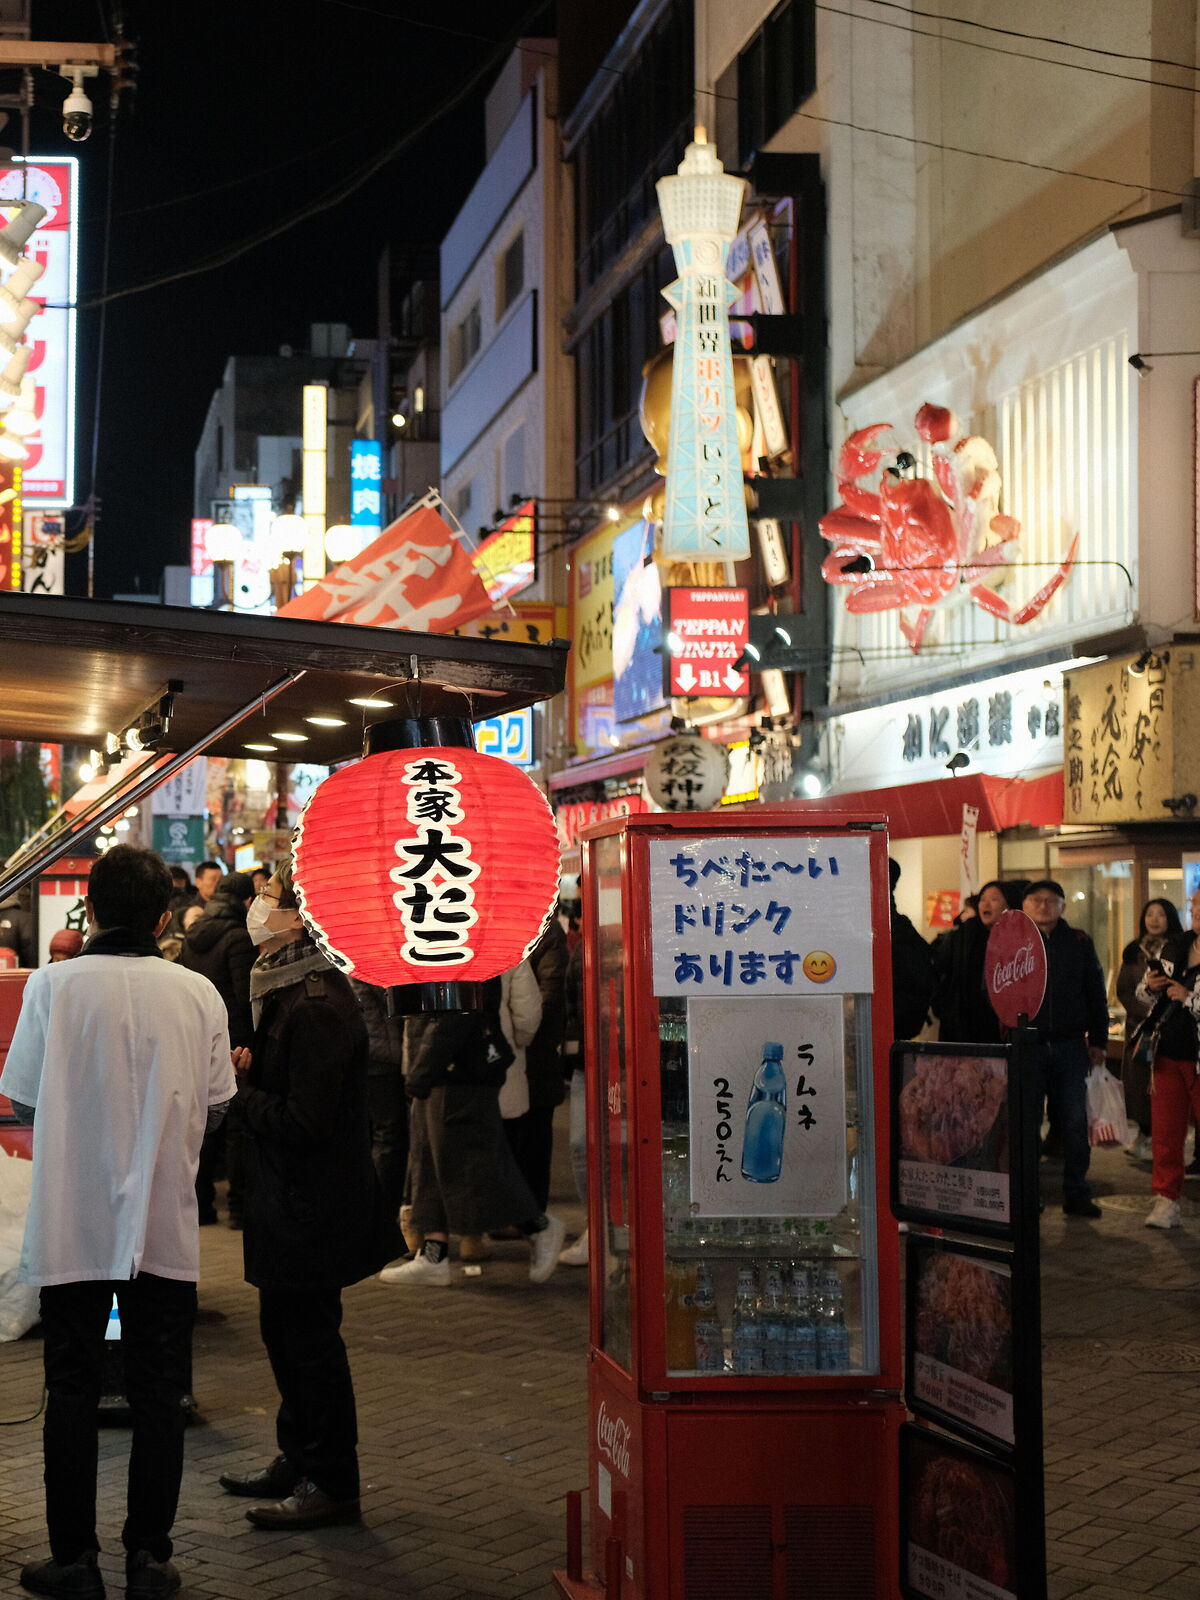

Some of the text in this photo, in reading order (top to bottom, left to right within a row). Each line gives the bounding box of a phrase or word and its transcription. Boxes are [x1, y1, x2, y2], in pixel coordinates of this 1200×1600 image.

[673, 618, 745, 636] TEPPAN
[699, 669, 721, 688] B1
[476, 717, 524, 755] コク
[398, 760, 475, 962] 本家大たこ
[674, 901, 793, 937] ドリンク
[673, 951, 801, 986] あります
[796, 1043, 817, 1130] ラムネ
[713, 1077, 734, 1183] 250えん
